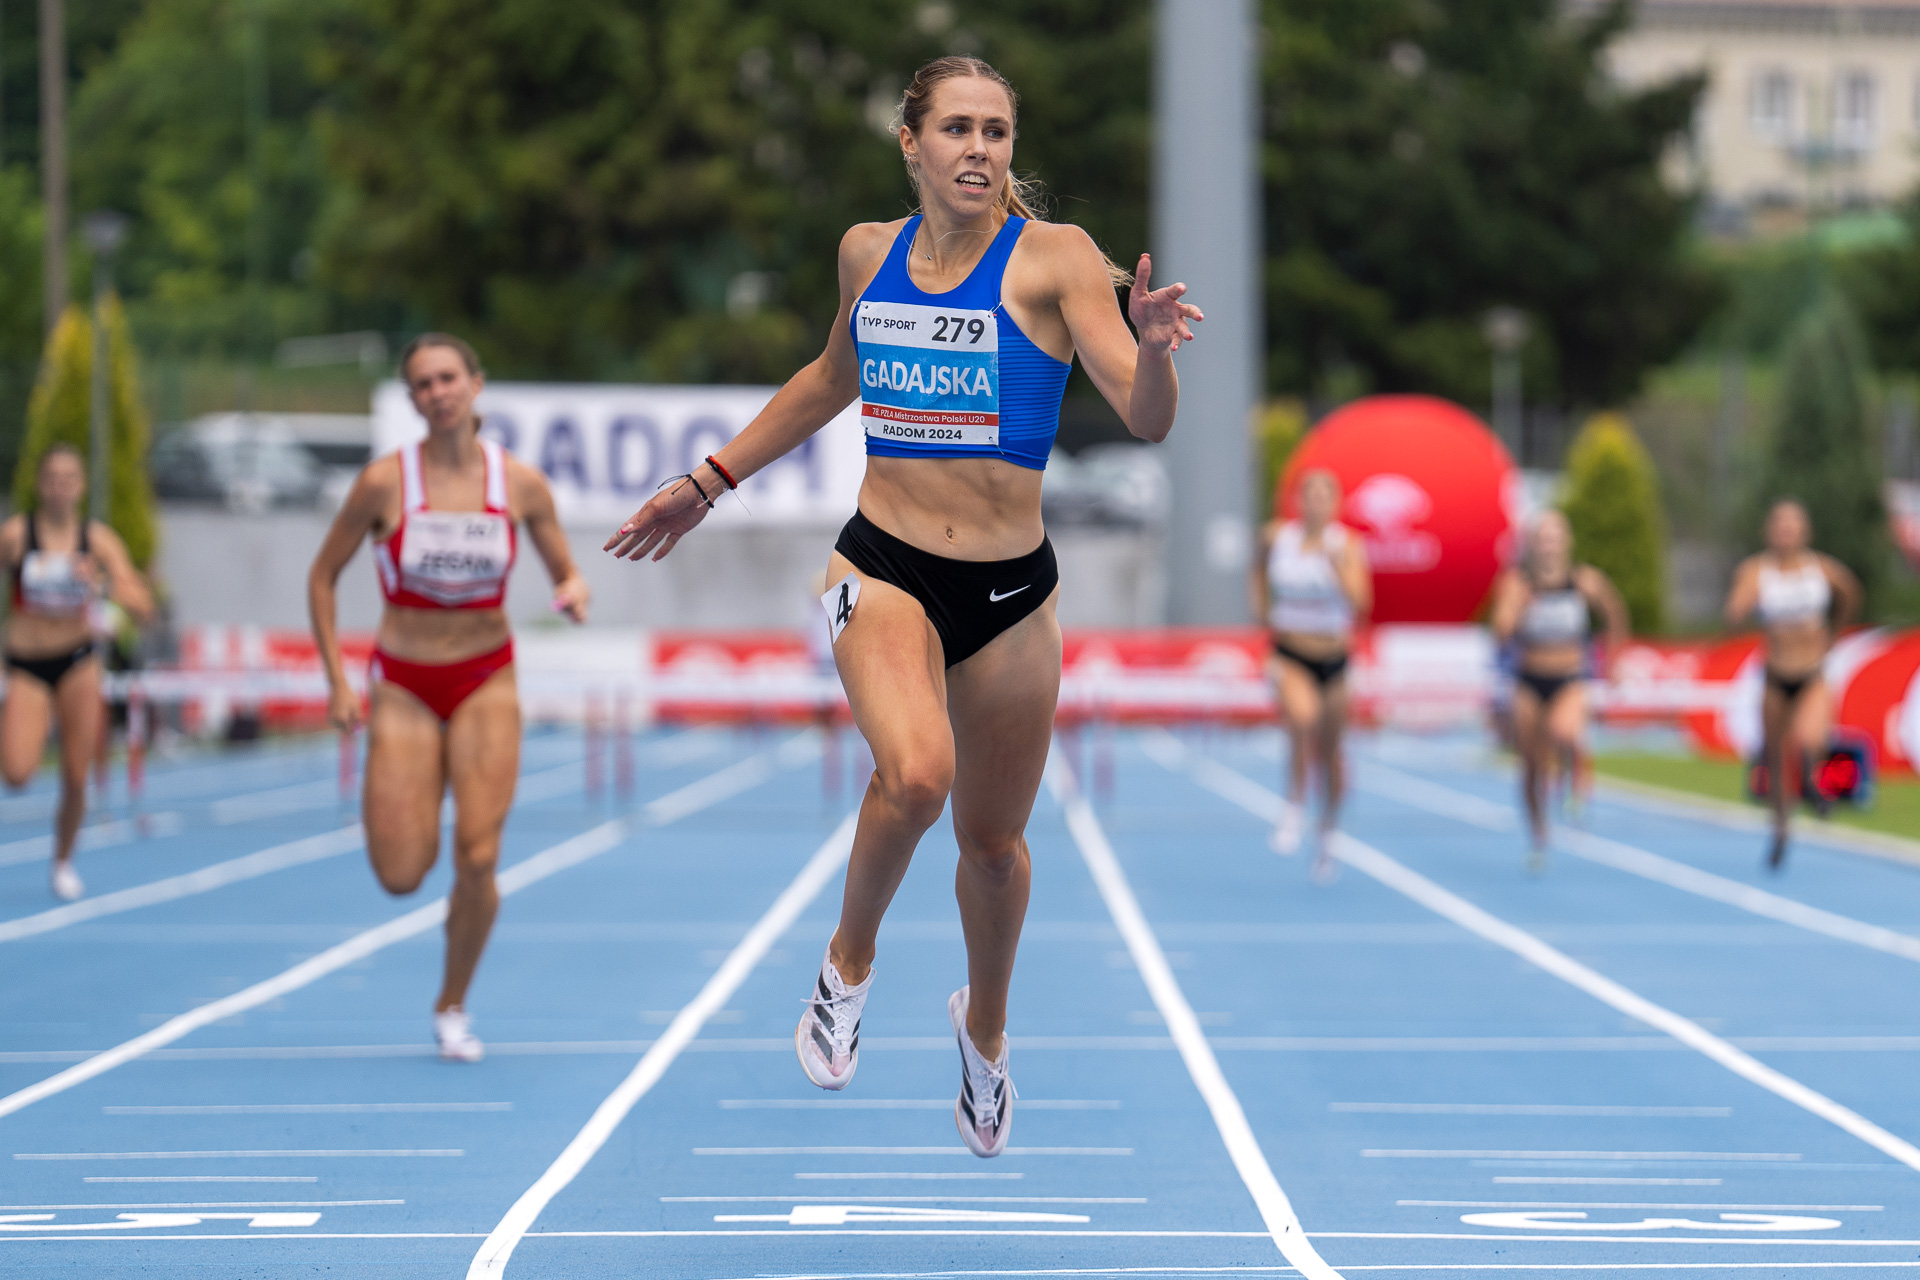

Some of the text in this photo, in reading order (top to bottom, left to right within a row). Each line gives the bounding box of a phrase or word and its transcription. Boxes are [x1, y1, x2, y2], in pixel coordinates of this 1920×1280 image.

[861, 315, 985, 344] TVP SPORT 279
[863, 358, 993, 397] GADAJSKA
[880, 408, 894, 418] PZLA
[894, 411, 940, 423] Mistrzostwa
[941, 414, 967, 423] Polski
[968, 415, 986, 424] U20
[882, 424, 963, 440] RADOM 2024
[836, 582, 852, 627] 4
